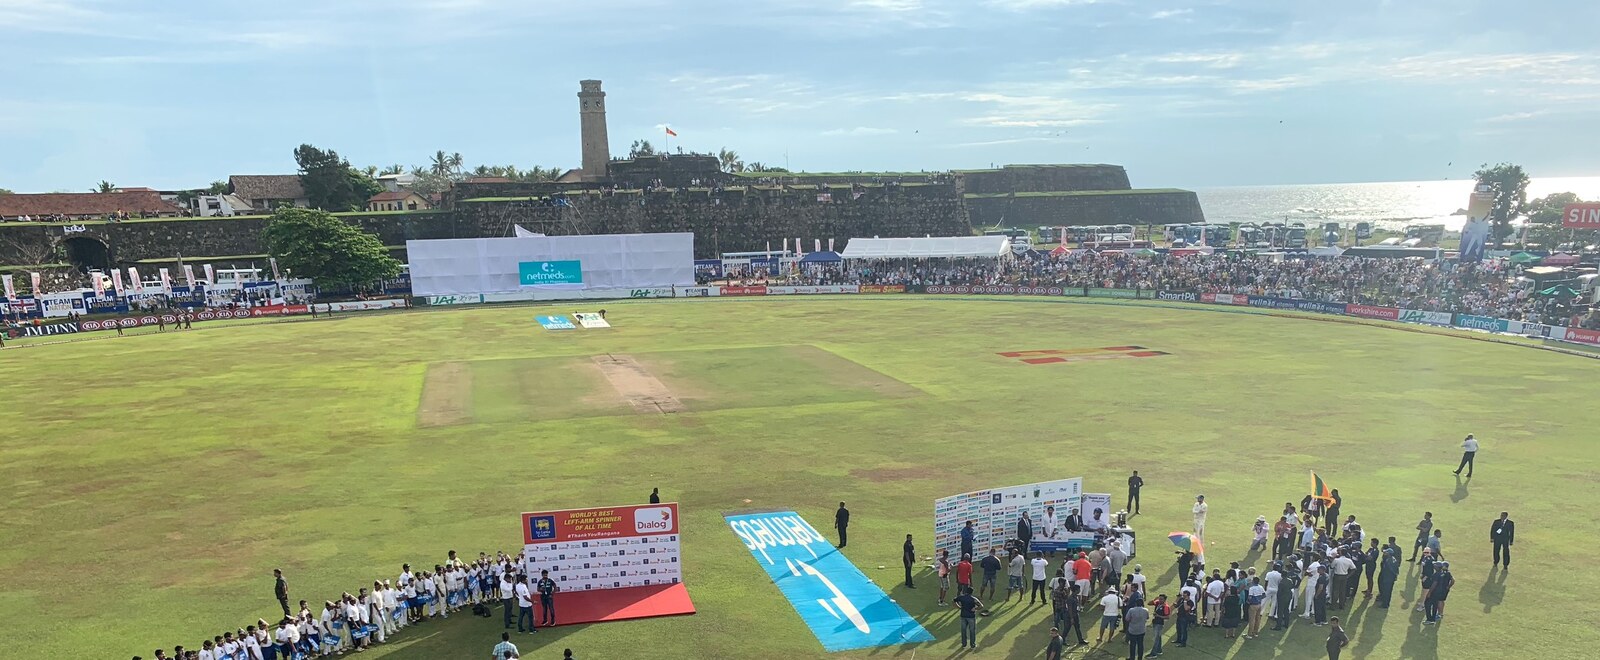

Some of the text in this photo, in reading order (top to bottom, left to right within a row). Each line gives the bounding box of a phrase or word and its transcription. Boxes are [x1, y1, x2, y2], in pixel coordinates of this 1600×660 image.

[1159, 291, 1196, 301] SmartPA
[1351, 306, 1394, 318] yorkshire.com
[24, 322, 78, 336] JM FINN
[1460, 318, 1500, 331] netmeds
[638, 520, 667, 530] Dialog
[730, 516, 824, 565] netmeds
